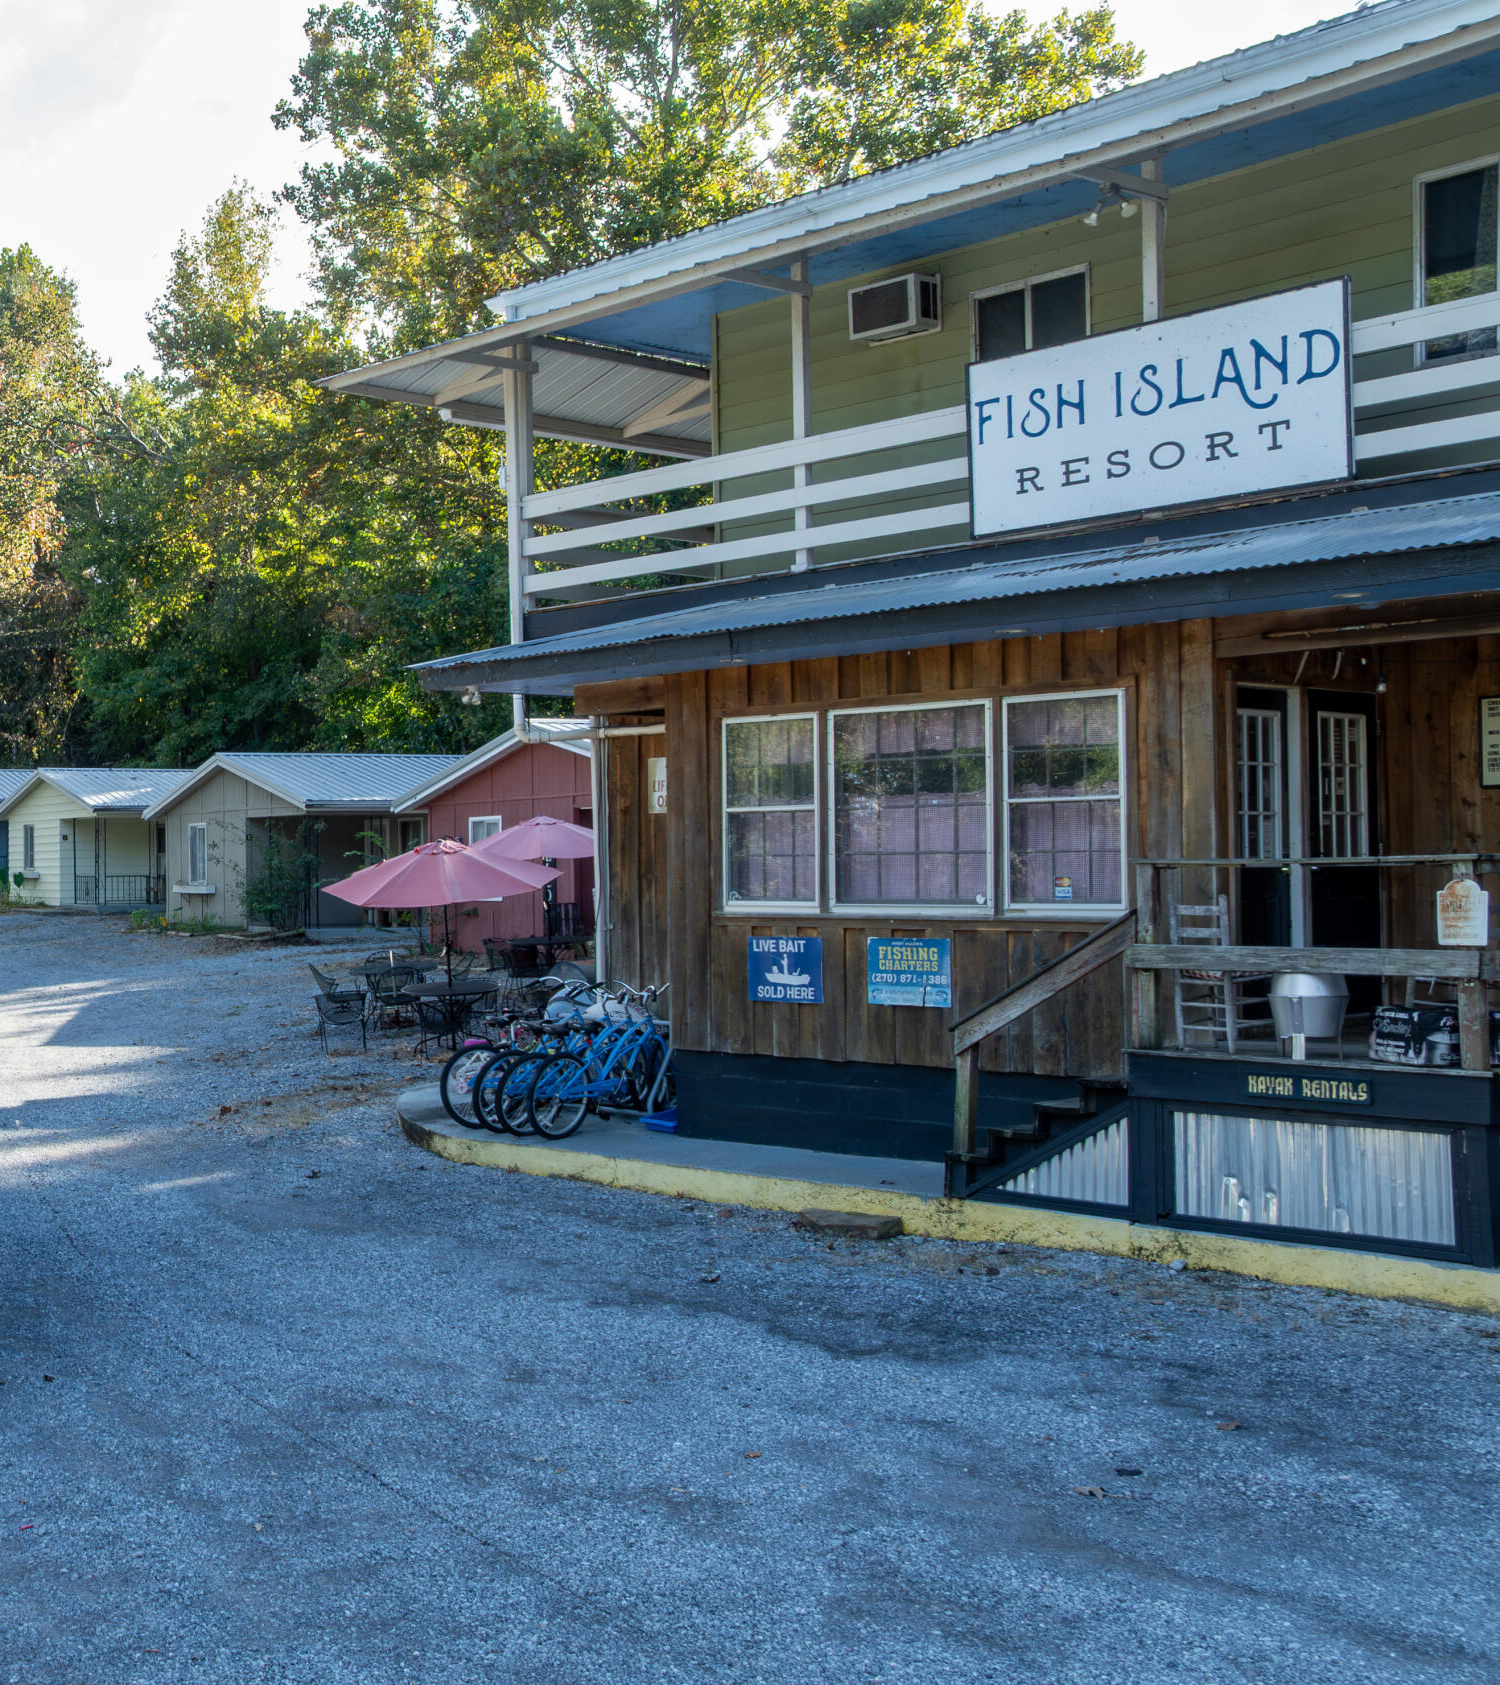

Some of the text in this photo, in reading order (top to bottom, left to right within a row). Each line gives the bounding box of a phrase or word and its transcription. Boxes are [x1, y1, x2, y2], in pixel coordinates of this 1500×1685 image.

[974, 328, 1341, 445] FISH ISLAND
[1015, 419, 1291, 494] RESORT
[752, 939, 807, 953] LIVE BAIT
[878, 946, 939, 961] FISHING
[878, 960, 939, 972] CHARTERS
[871, 973, 897, 984] (270)
[757, 985, 816, 1000] SOLD HERE
[1248, 1075, 1368, 1101] KAYAK RENTALS
